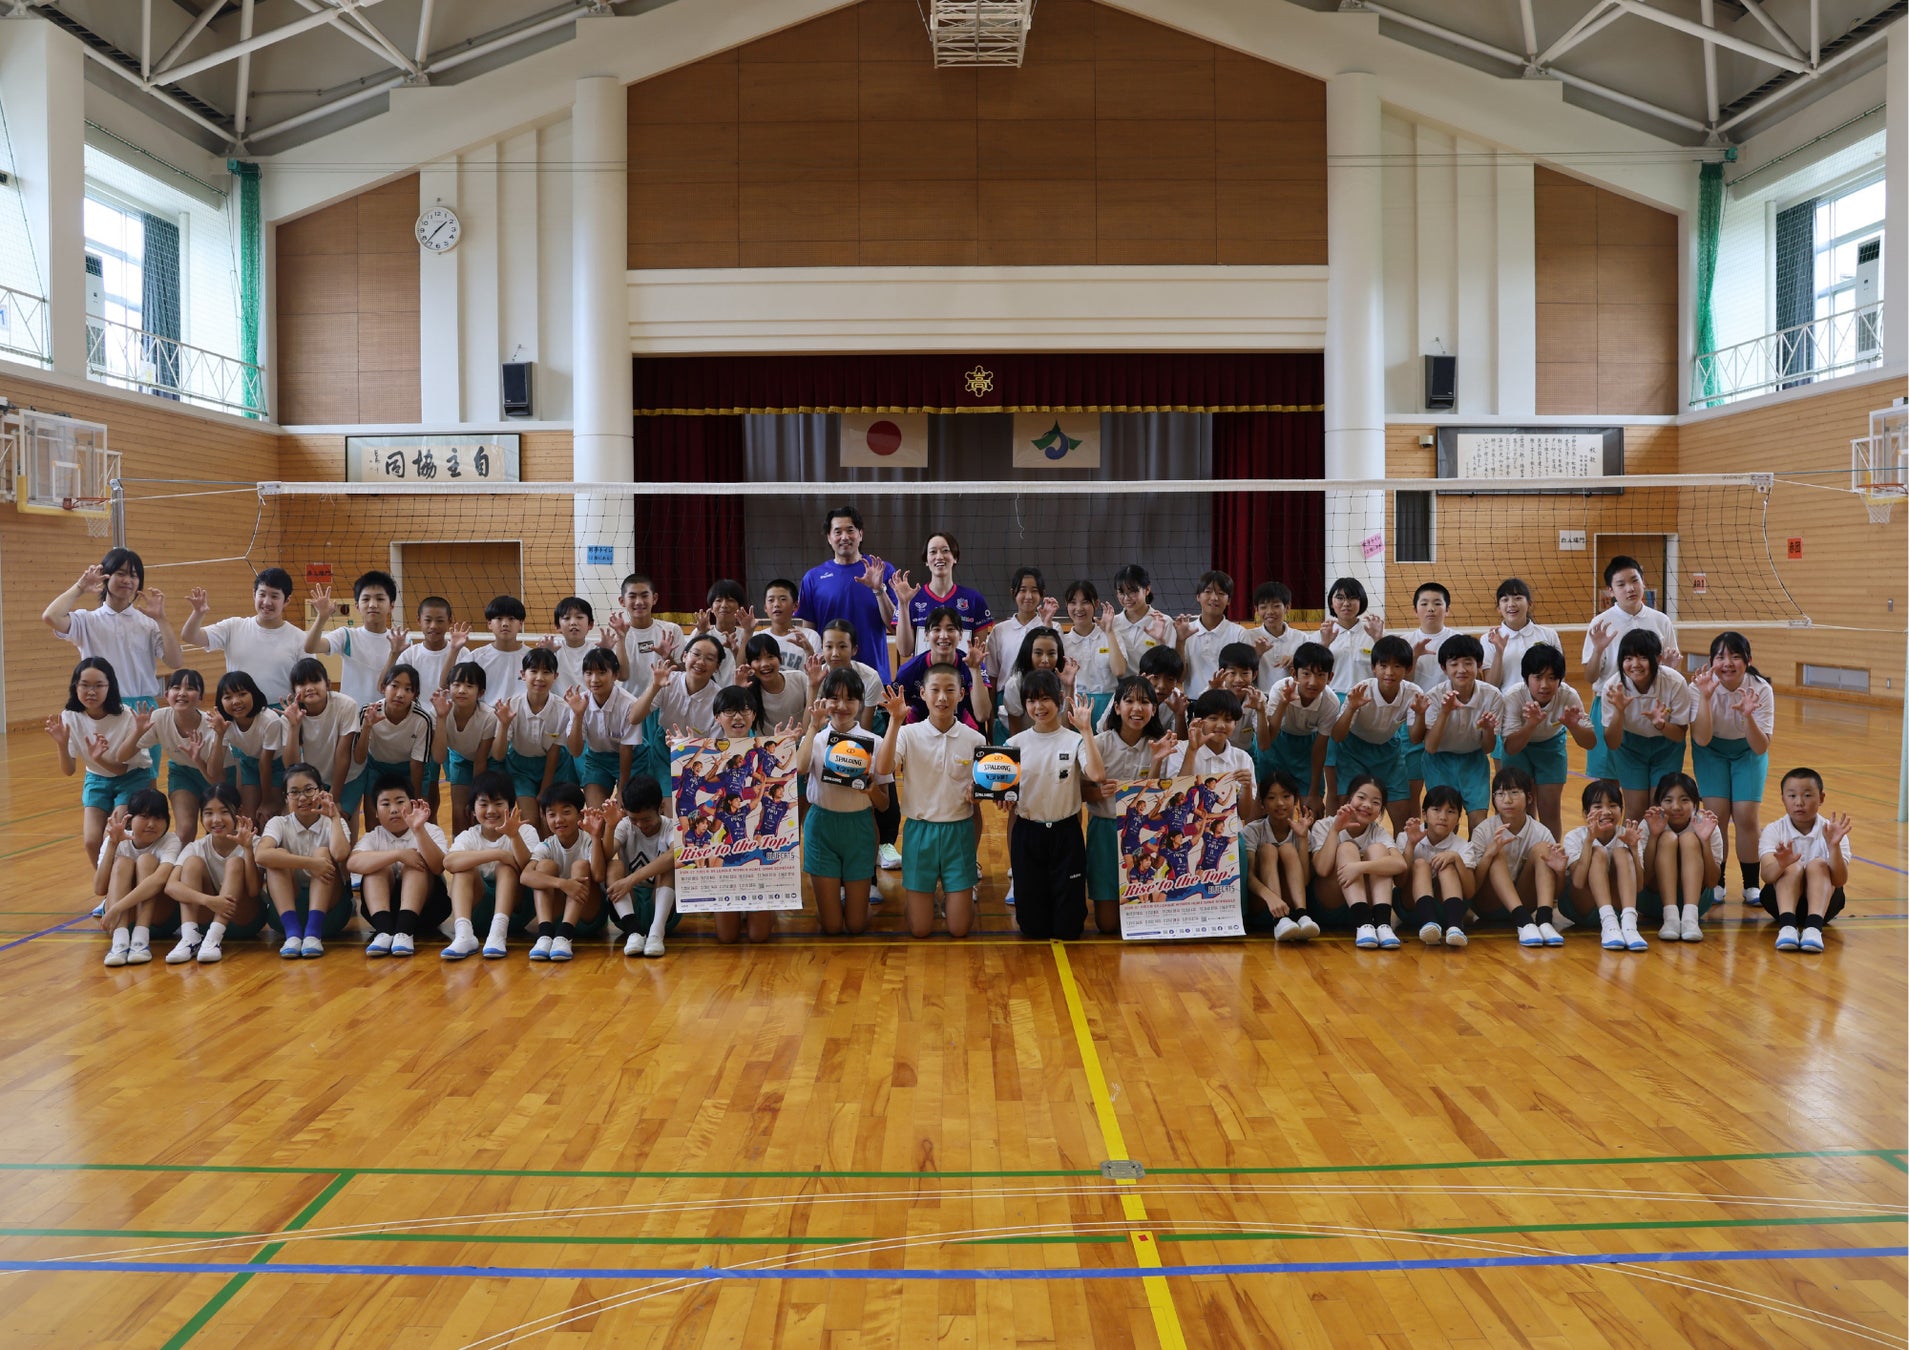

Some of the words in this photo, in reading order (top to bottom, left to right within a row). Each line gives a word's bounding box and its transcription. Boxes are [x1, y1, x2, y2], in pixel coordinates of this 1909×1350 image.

[835, 754, 863, 767] SPALDING
[983, 764, 1011, 772] SPALDING
[680, 847, 712, 861] Rise
[715, 844, 729, 855] to
[733, 839, 757, 853] the
[762, 833, 794, 850] Top!
[1124, 883, 1155, 897] Rise
[1160, 880, 1173, 892] to
[1176, 874, 1199, 888] the
[1203, 867, 1235, 884] Top!
